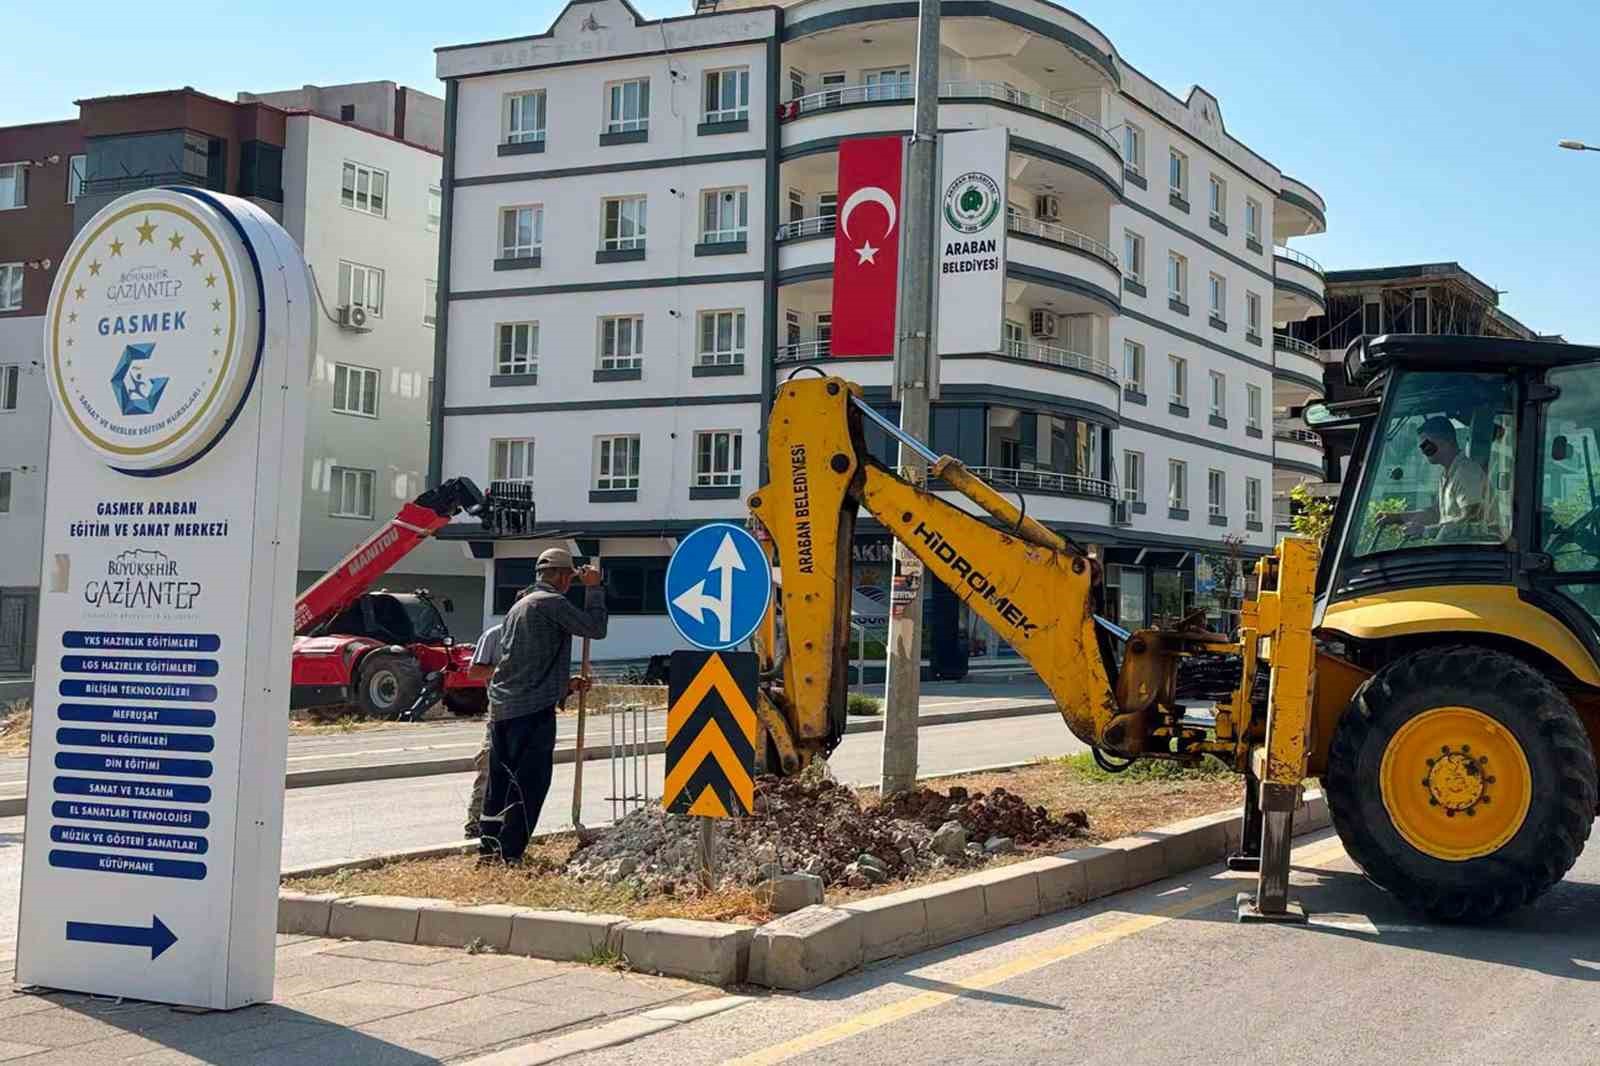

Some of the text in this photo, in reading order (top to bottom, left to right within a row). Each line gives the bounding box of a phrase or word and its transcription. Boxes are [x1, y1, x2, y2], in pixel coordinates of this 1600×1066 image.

[945, 239, 997, 256] ARABAN
[942, 257, 999, 274] BELEDİYESİ
[97, 311, 187, 336] GASMEK
[79, 394, 101, 421] SANAT
[100, 419, 109, 428] VE
[109, 424, 137, 436] MESLEK
[96, 500, 197, 516] GASMEK ARABAN
[790, 443, 814, 574] ARABAN BELEDİYESİ
[70, 518, 228, 537] EĞİTİM VE SANAT MERKEZİ
[348, 526, 400, 577] MANITOU
[107, 560, 179, 579] BÜYÜKŞEHİR
[84, 577, 202, 609] GAZİANTEP
[84, 635, 198, 649] YKS HAZIRLIK EĞİTİMLERİ
[82, 660, 197, 673] LGS HAZIRLIK EĞİTİMLERİ
[85, 682, 191, 697] BİLİŞİM TEKNOLOJİLERİ
[112, 709, 159, 722] MEFRUŞAT
[100, 732, 168, 746] DİL EĞİTİMLERİ
[105, 757, 122, 769] DİN
[89, 783, 174, 798] SANAT VE TASARIM
[70, 805, 192, 823] EL SANATLARI TEKNOLOJİSİ
[61, 830, 198, 850] MÜZİK VE GÖSTERİ SANATLARI
[99, 857, 155, 872] KÜTÜPHANE
